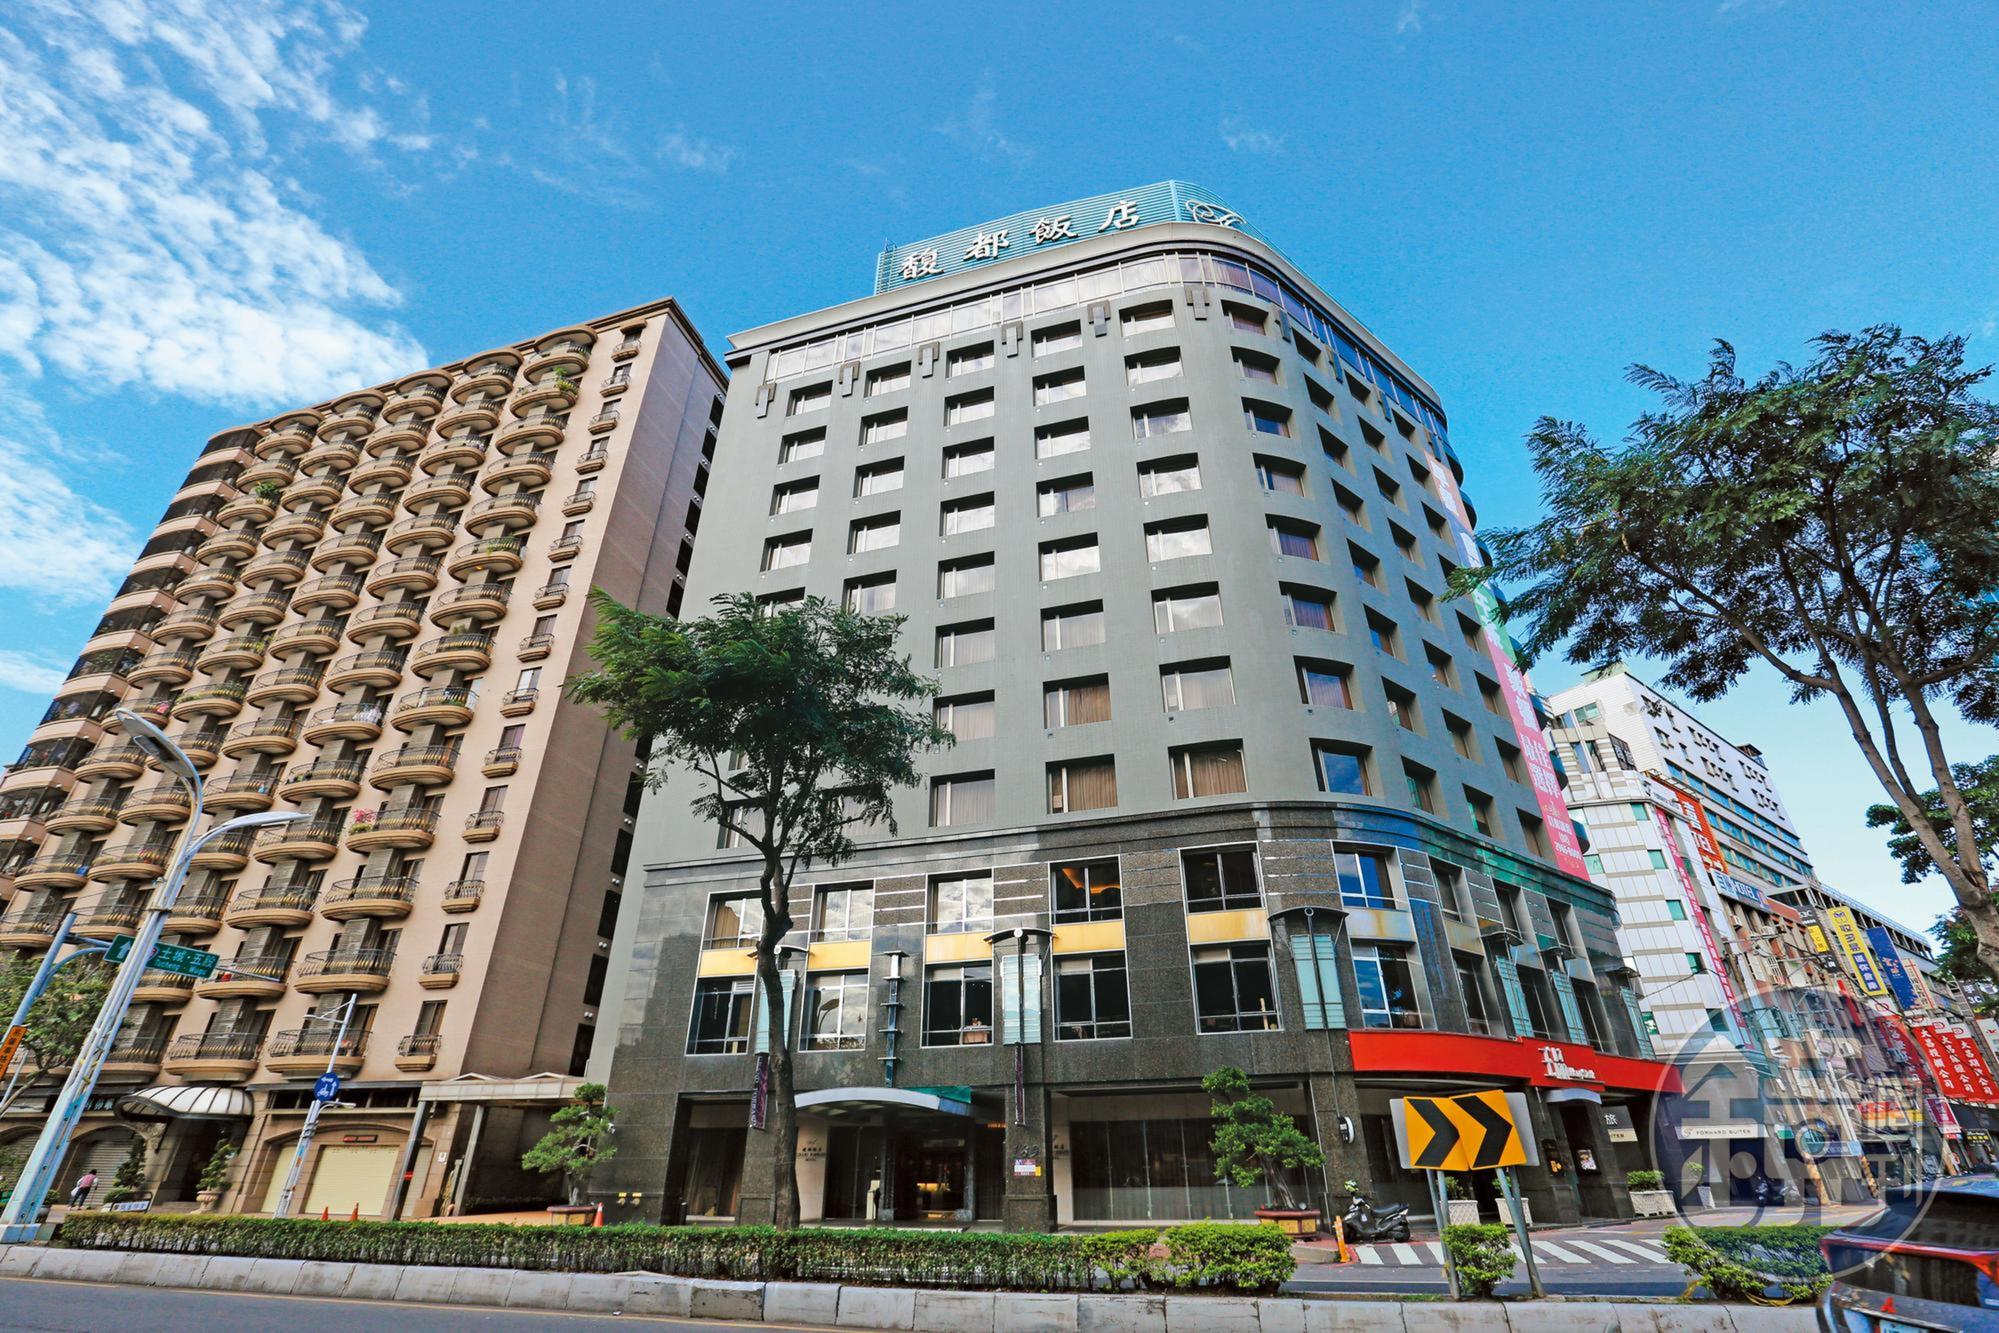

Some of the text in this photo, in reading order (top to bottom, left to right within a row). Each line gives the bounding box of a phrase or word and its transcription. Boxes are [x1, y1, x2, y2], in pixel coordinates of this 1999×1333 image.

[899, 199, 1141, 281] 馥都飯店
[1967, 995, 1983, 1005] 3C
[1603, 1113, 1618, 1125] 旅
